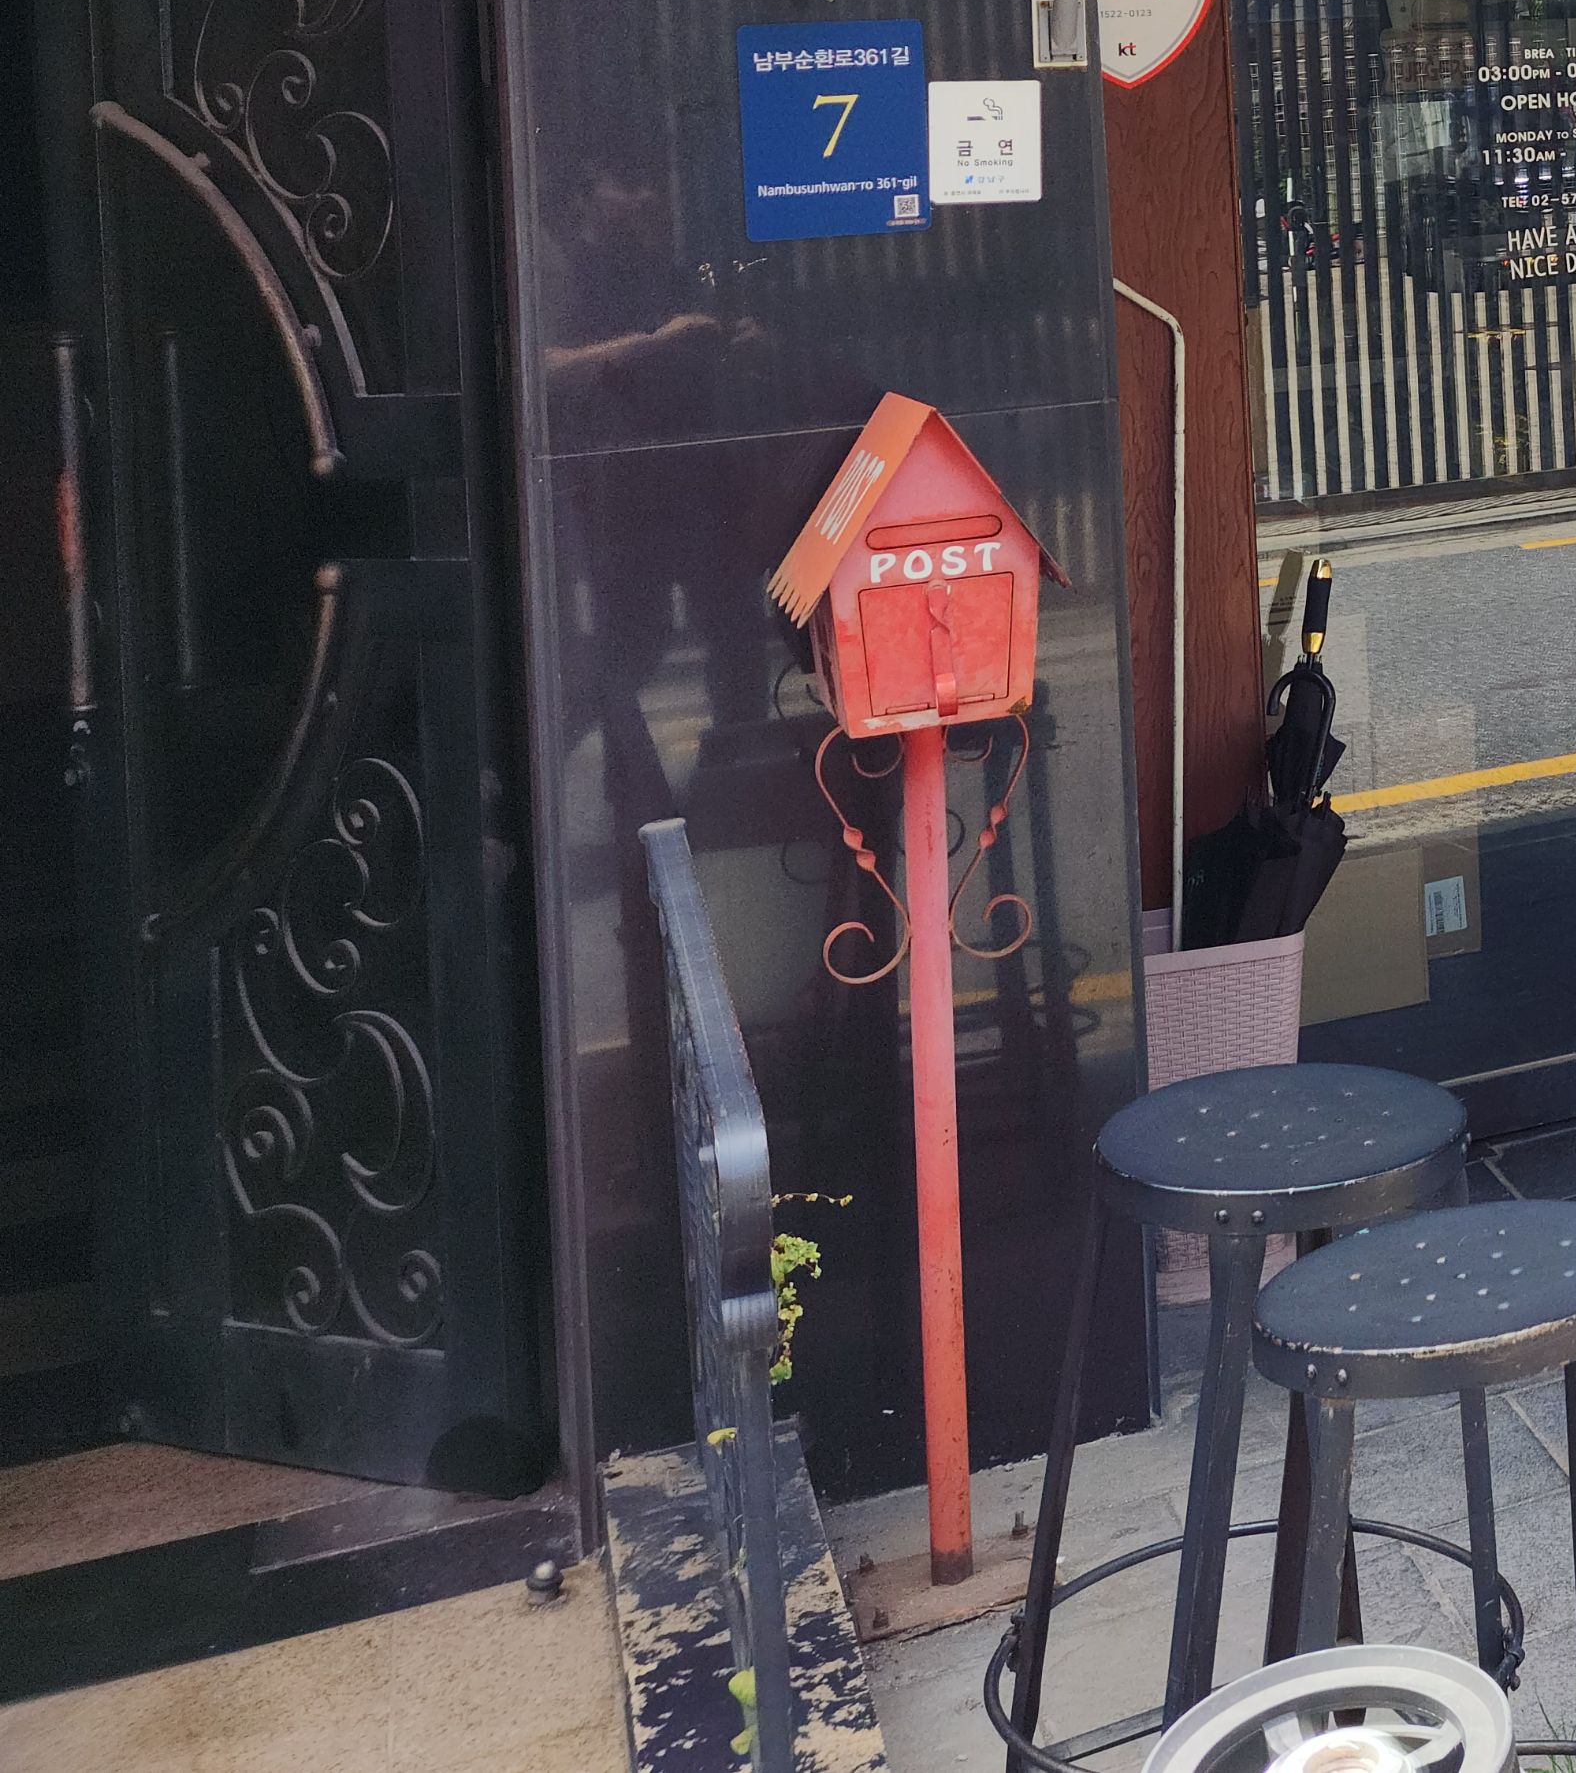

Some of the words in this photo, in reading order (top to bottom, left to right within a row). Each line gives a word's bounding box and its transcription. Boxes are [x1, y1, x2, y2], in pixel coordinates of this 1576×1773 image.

[1099, 9, 1152, 19] 1522-0123
[753, 45, 911, 73] 남부순환로361길
[1118, 42, 1137, 57] kt
[1478, 64, 1551, 83] 03:00PM
[1500, 93, 1551, 111] OPEN
[812, 94, 860, 159] 7
[1495, 130, 1553, 144] MONDAY
[1556, 131, 1569, 140] TO
[956, 140, 974, 157] 금
[998, 138, 1013, 156] 연
[1482, 147, 1556, 166] 11:30AM
[957, 159, 970, 167] No
[974, 158, 1013, 167] Smoking
[757, 179, 874, 198] Nambusunhwan-ro
[876, 176, 917, 191] 361-gil
[1507, 225, 1559, 252] HAVE
[1509, 254, 1560, 281] NICE
[870, 542, 1002, 584] POST
